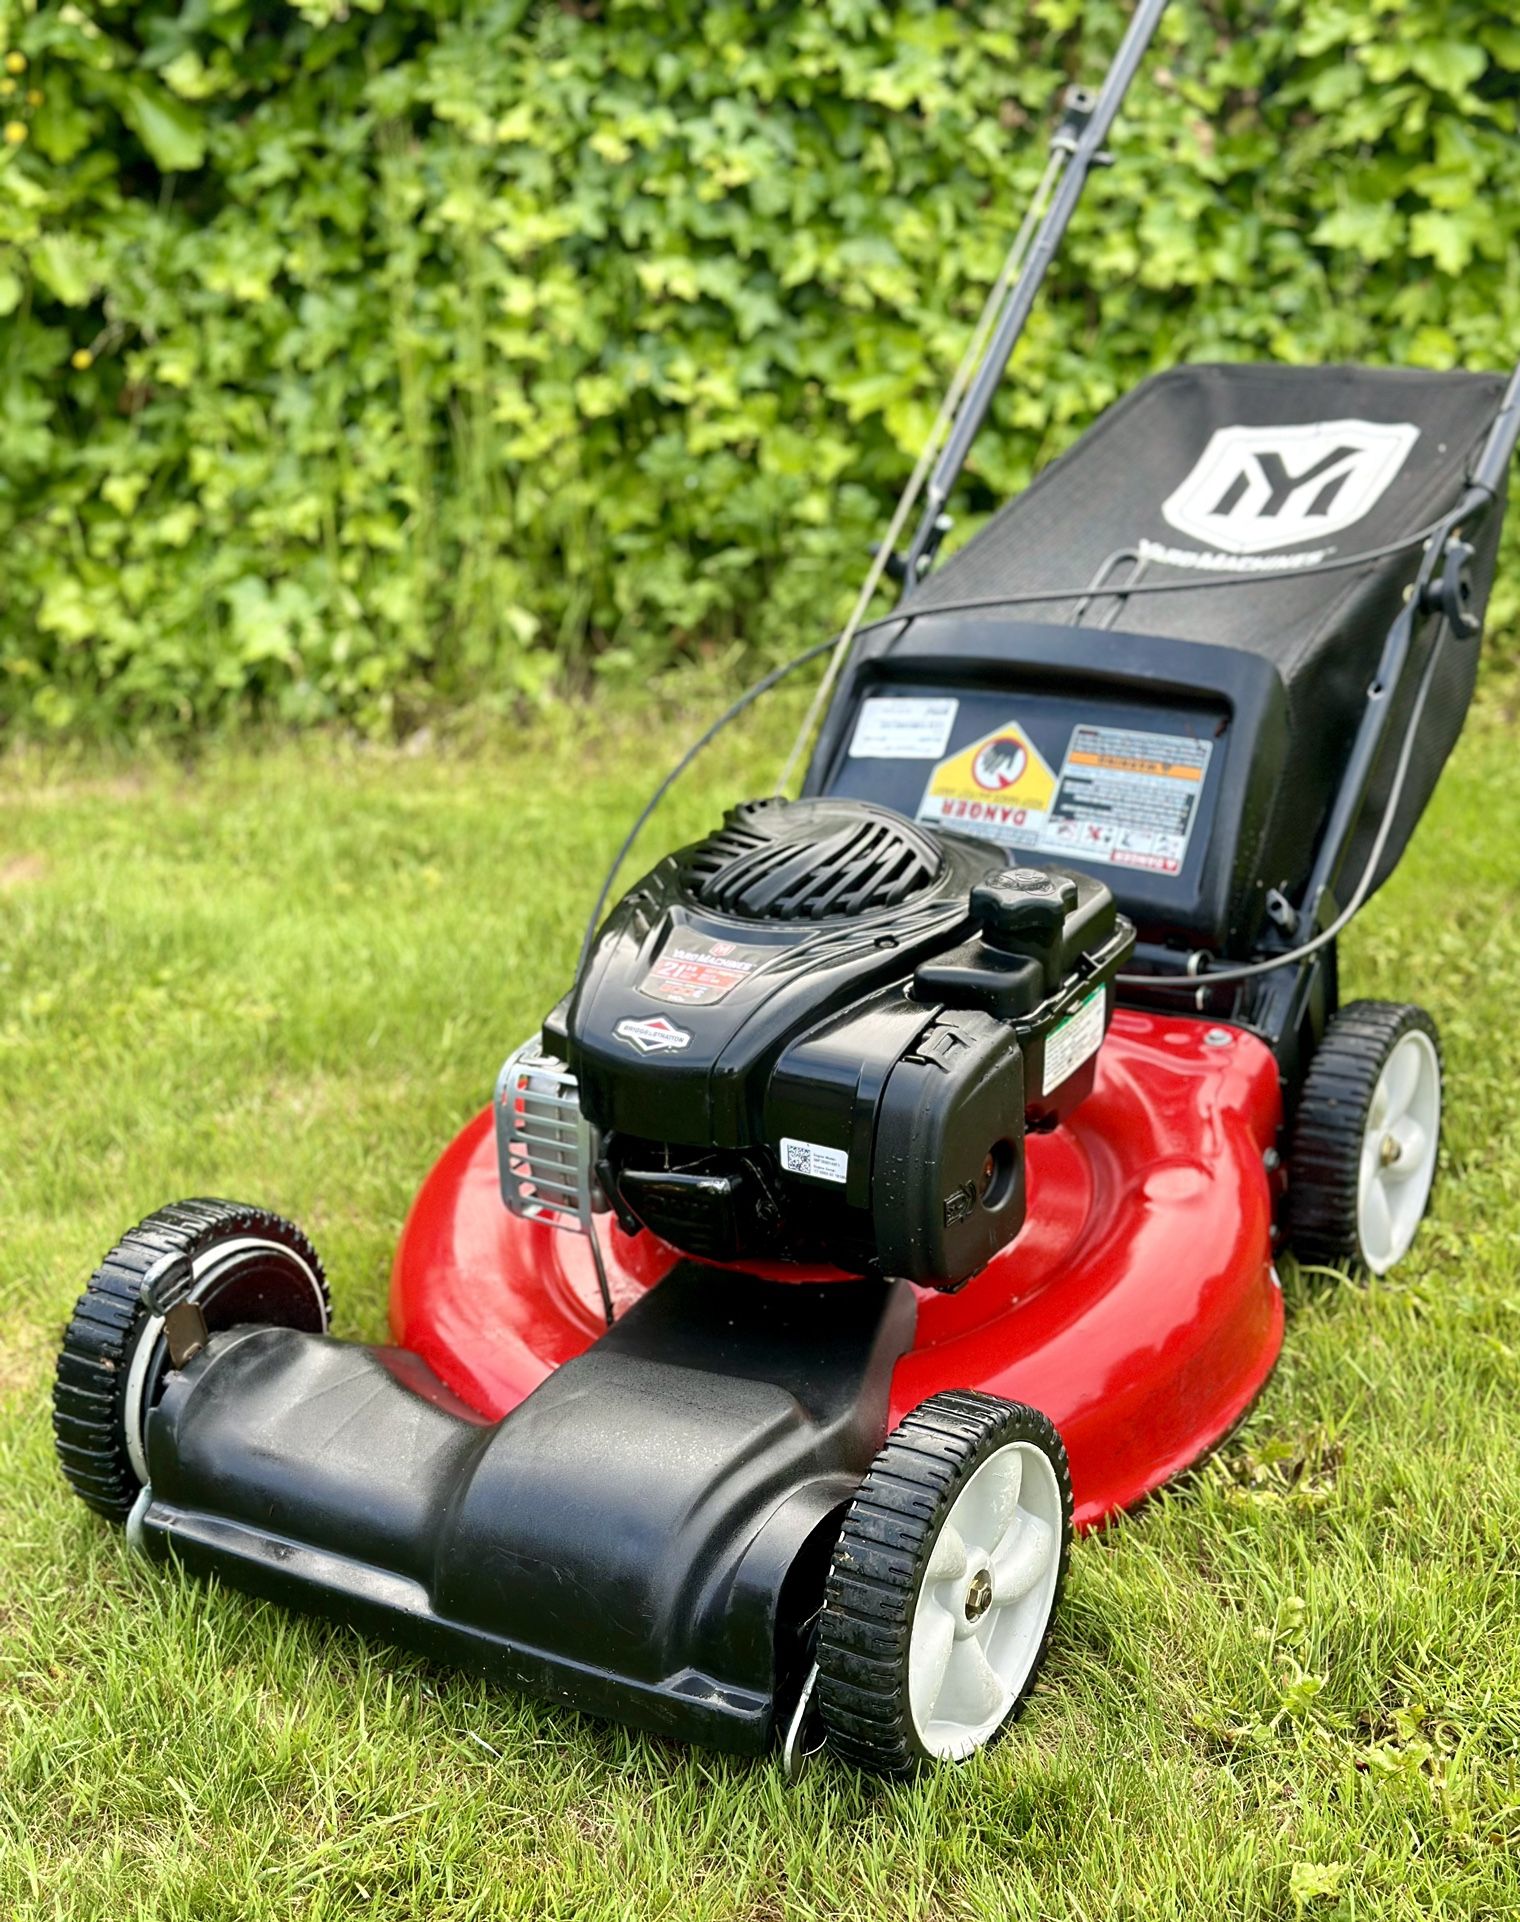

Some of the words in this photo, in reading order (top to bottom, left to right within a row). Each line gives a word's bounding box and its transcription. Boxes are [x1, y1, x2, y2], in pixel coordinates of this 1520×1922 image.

[941, 801, 1027, 826] DANGER
[658, 961, 686, 977] 21
[623, 1025, 649, 1036] BRIGGS
